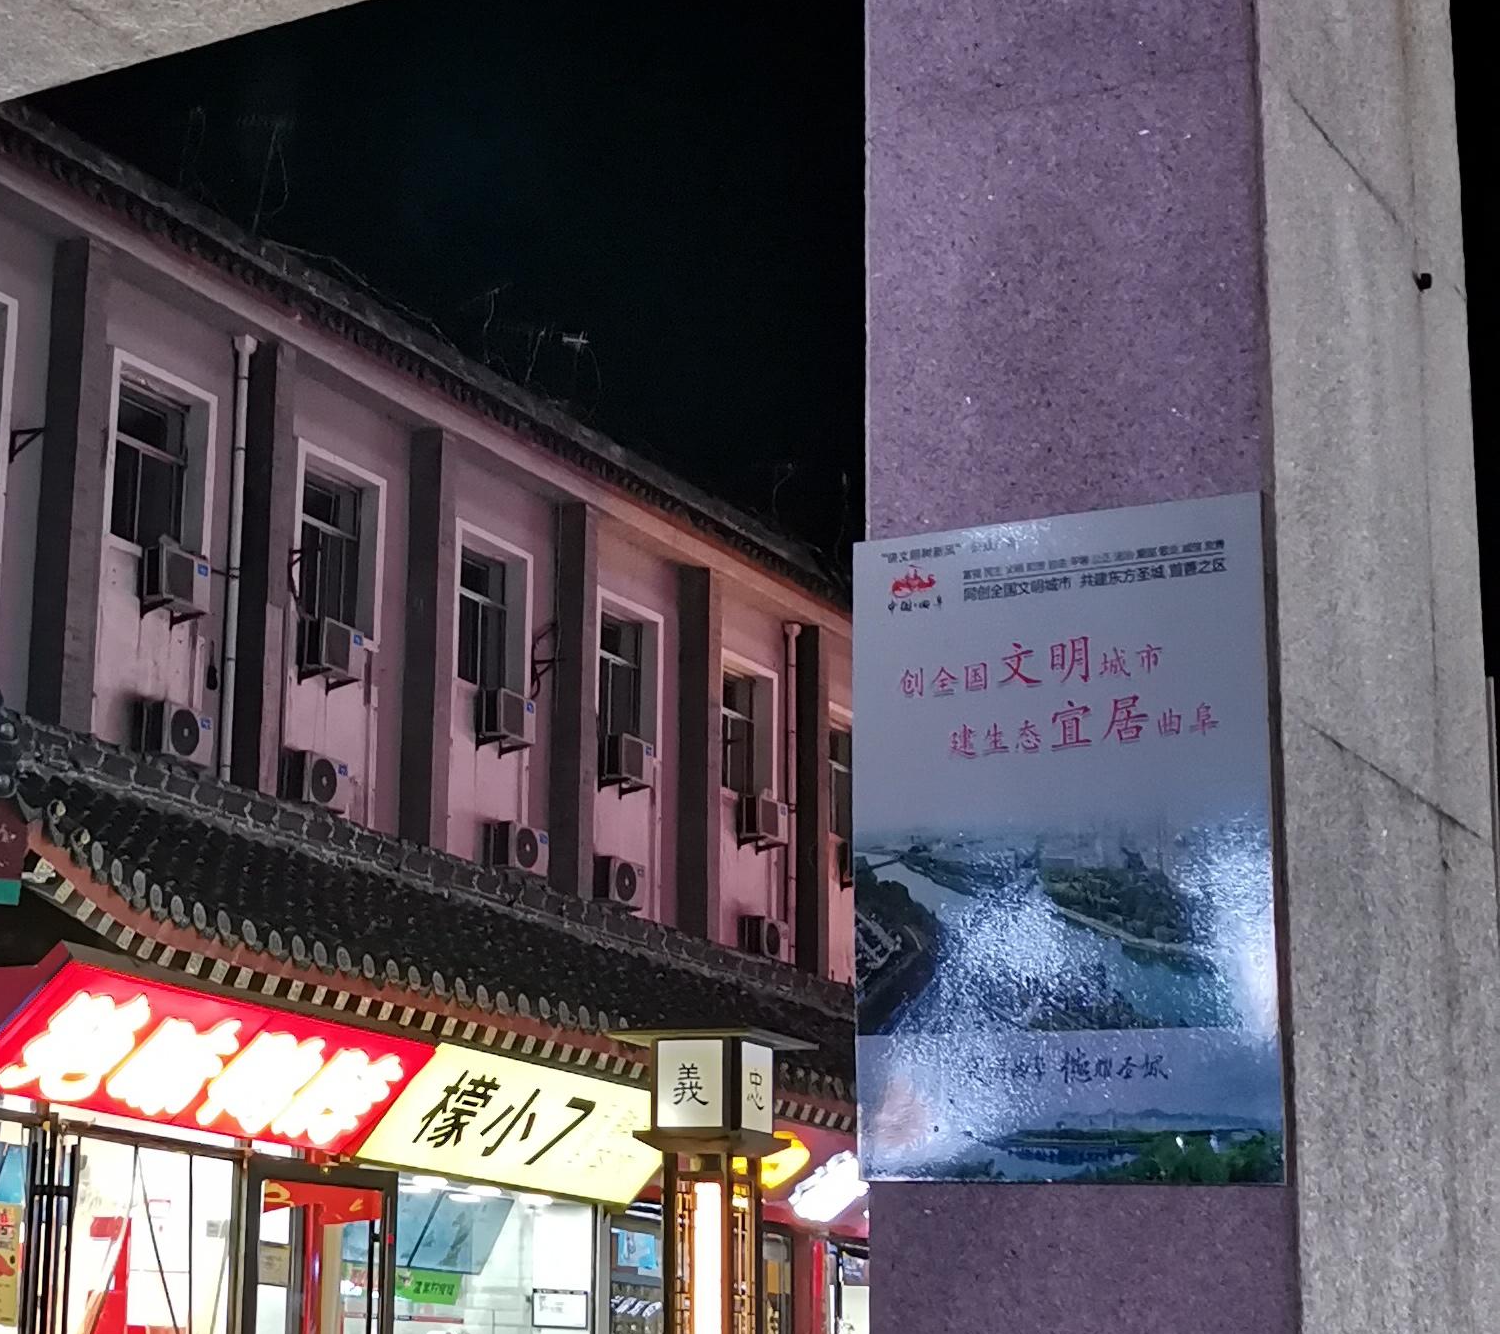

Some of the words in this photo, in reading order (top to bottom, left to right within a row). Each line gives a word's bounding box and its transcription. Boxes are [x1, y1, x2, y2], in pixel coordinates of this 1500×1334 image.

[900, 636, 1163, 697] 创全国文明城市
[949, 695, 1220, 758] 建生态宜居曲阜
[673, 1063, 709, 1105] 義
[747, 1068, 764, 1110] 忠
